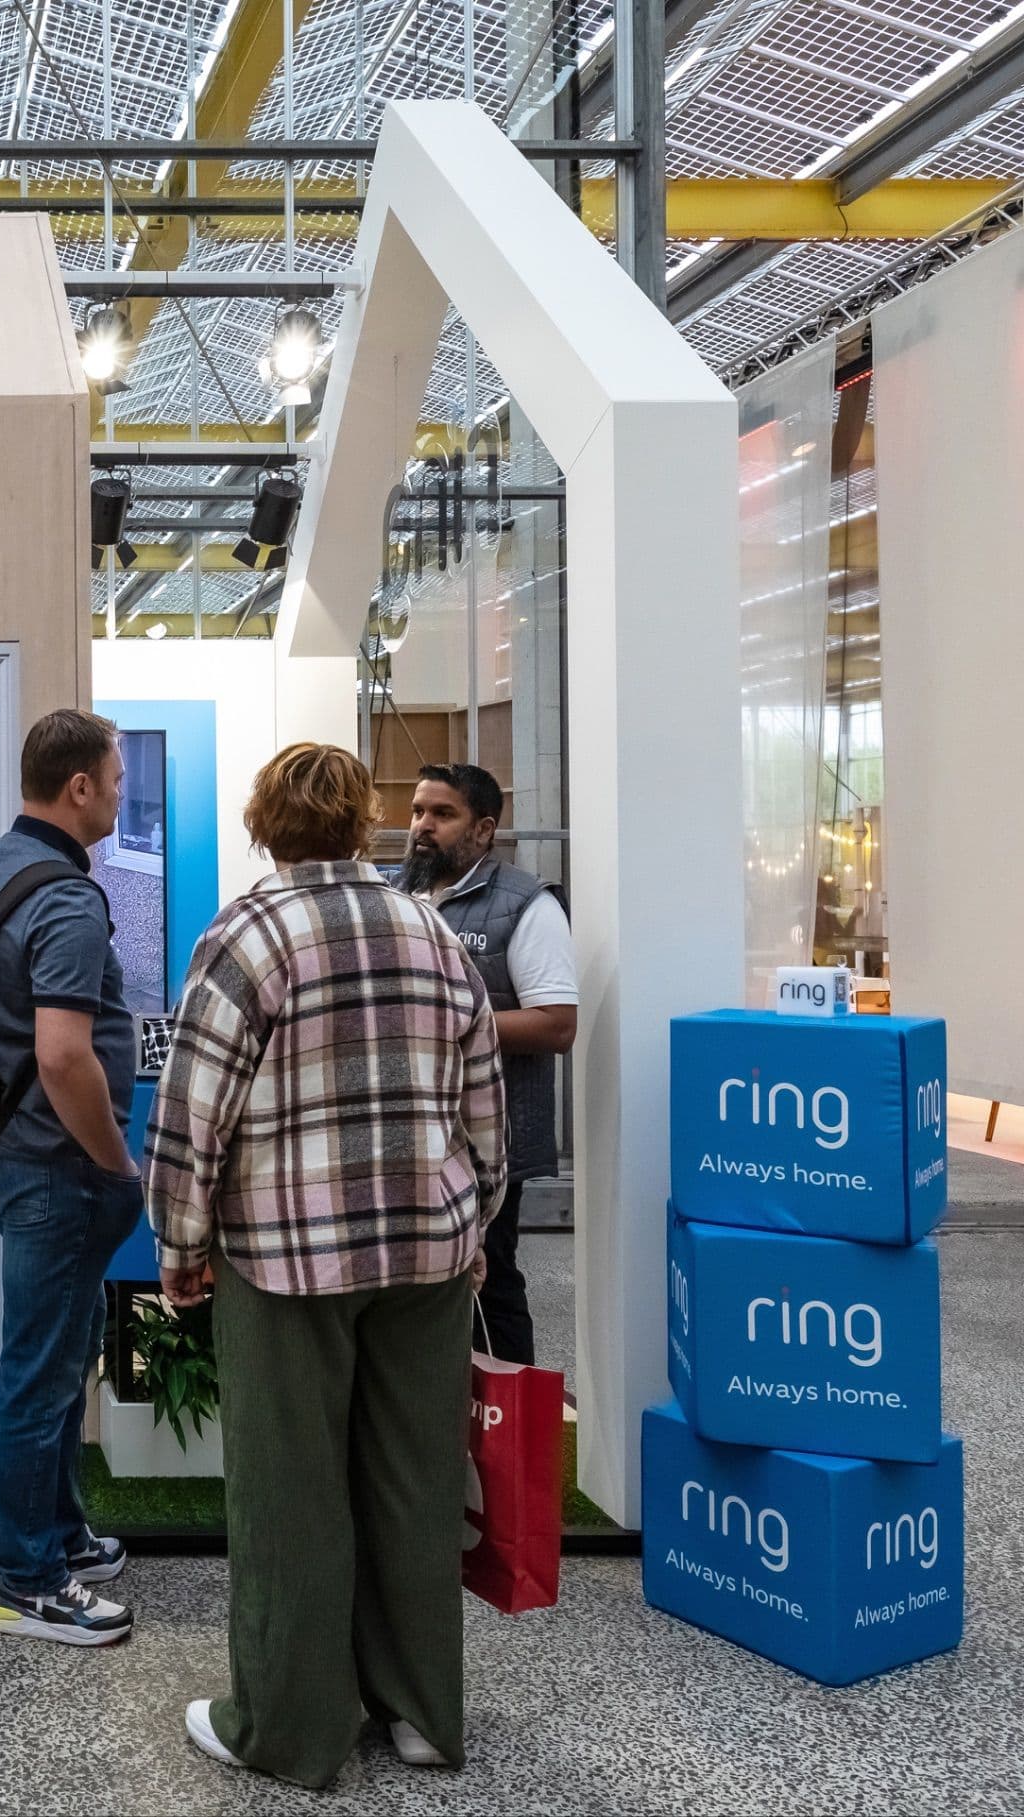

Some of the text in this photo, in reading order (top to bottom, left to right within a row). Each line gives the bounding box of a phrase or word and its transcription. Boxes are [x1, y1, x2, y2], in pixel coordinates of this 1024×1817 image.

[780, 978, 826, 1007] ring
[719, 1068, 849, 1150] ring
[917, 1078, 941, 1139] ring
[698, 1153, 873, 1192] Always home.
[671, 1259, 689, 1336] ring
[746, 1286, 883, 1367] ring
[727, 1375, 908, 1408] Always home.
[681, 1480, 789, 1573] ring
[866, 1506, 938, 1570] ring
[665, 1548, 809, 1622] Always home.
[854, 1585, 950, 1629] Always home.
